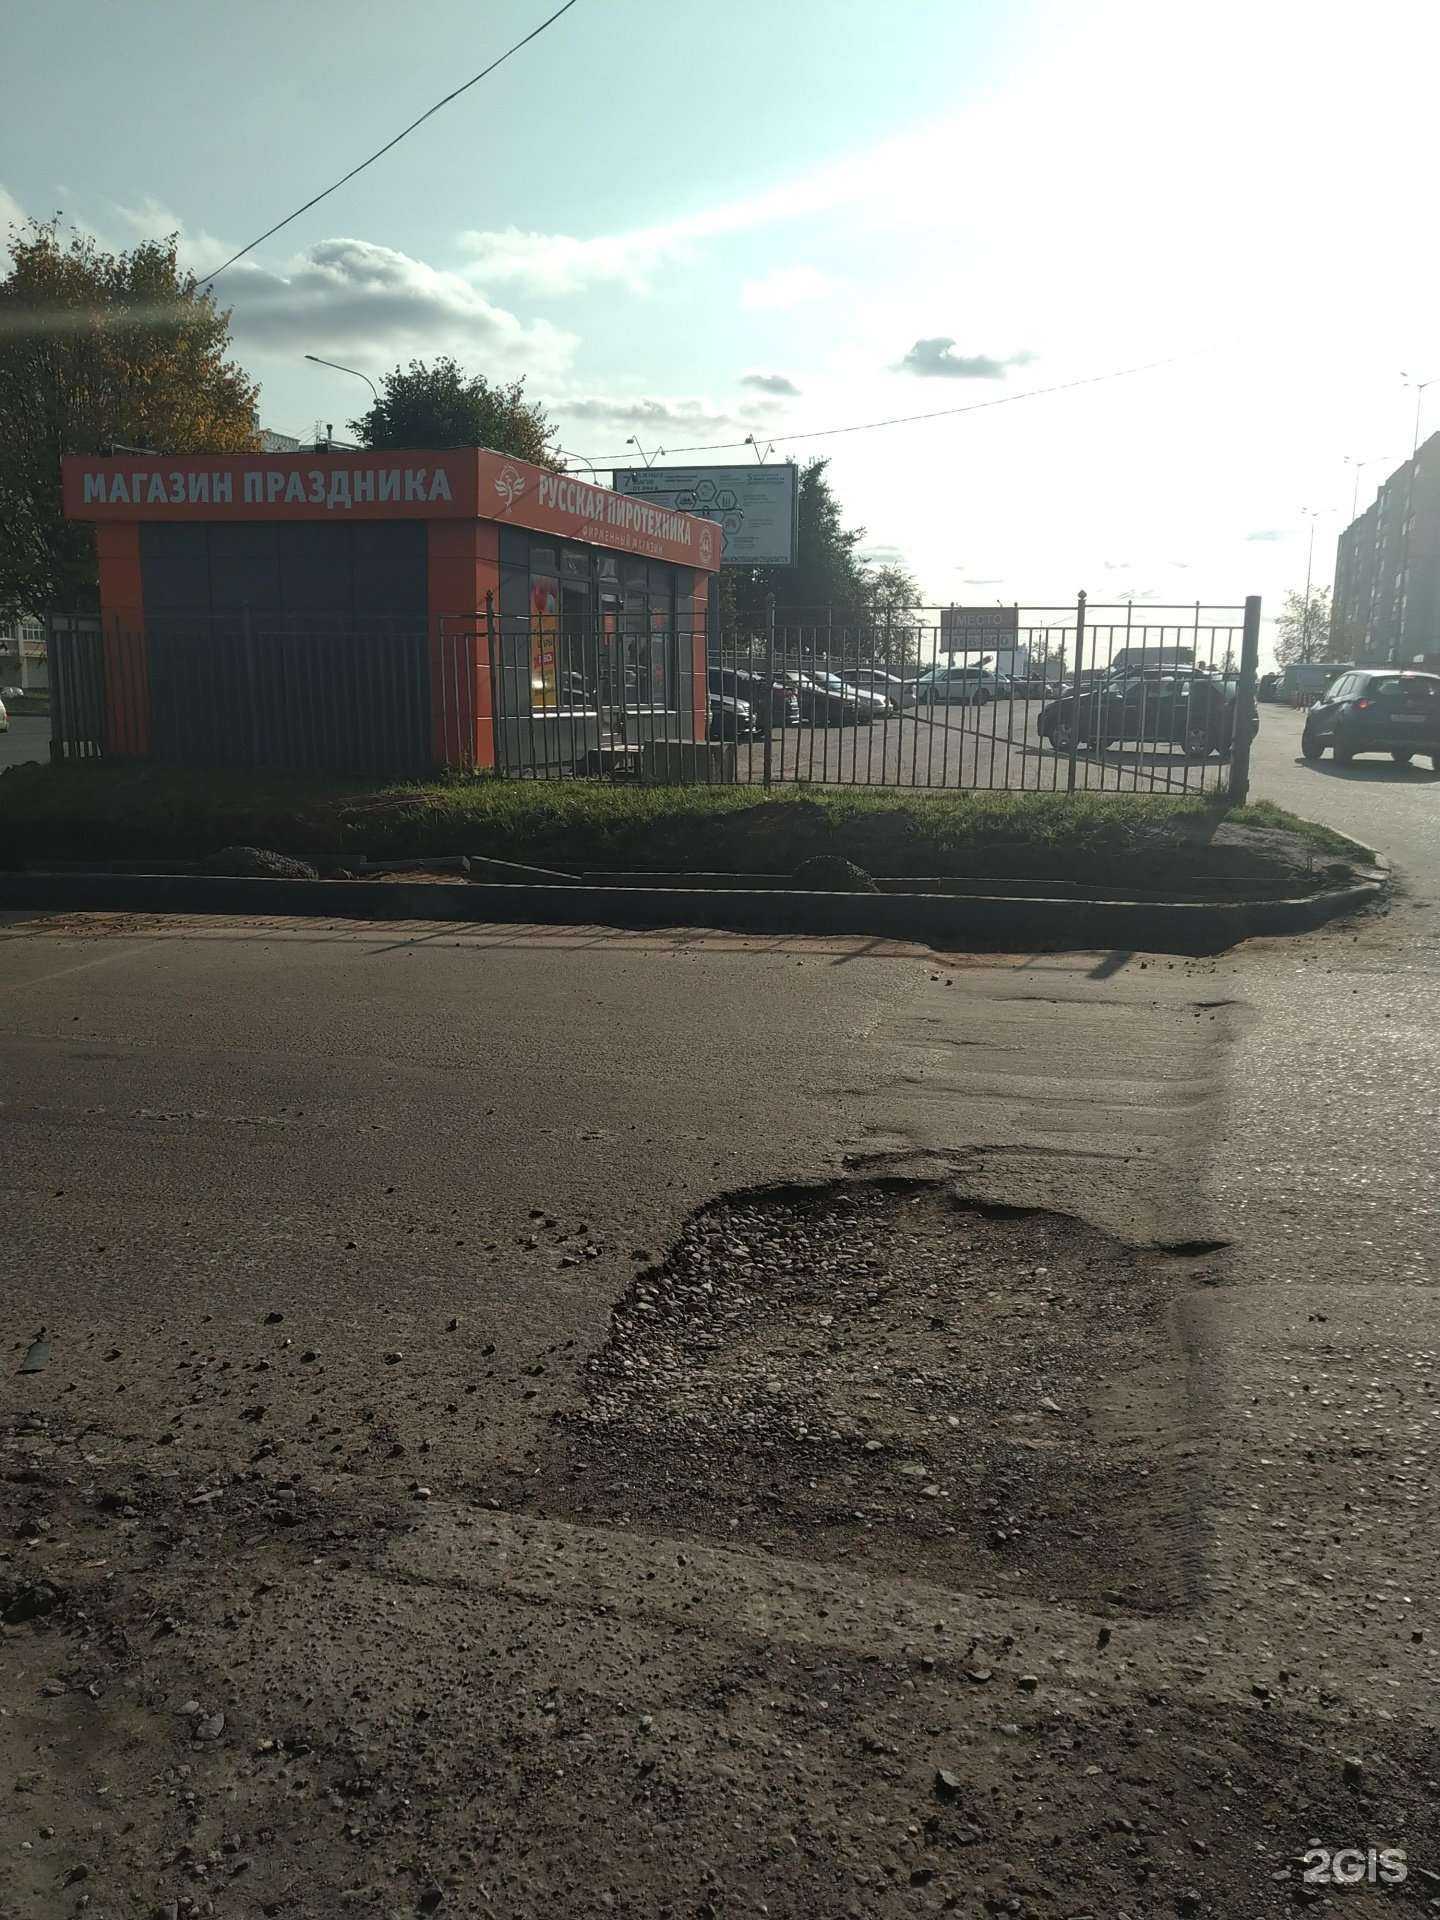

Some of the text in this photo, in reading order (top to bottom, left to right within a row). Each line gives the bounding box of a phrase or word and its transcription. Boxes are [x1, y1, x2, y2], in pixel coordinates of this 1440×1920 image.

[84, 468, 454, 509] МАГАЗИН ПРАЗДНИКА
[538, 476, 692, 546] РУССКАЯ ПИРОТЕХНИКА
[582, 525, 663, 553] ФИРМЕННЫЙ МАГАЗИН
[959, 615, 1001, 625] МЕСТО
